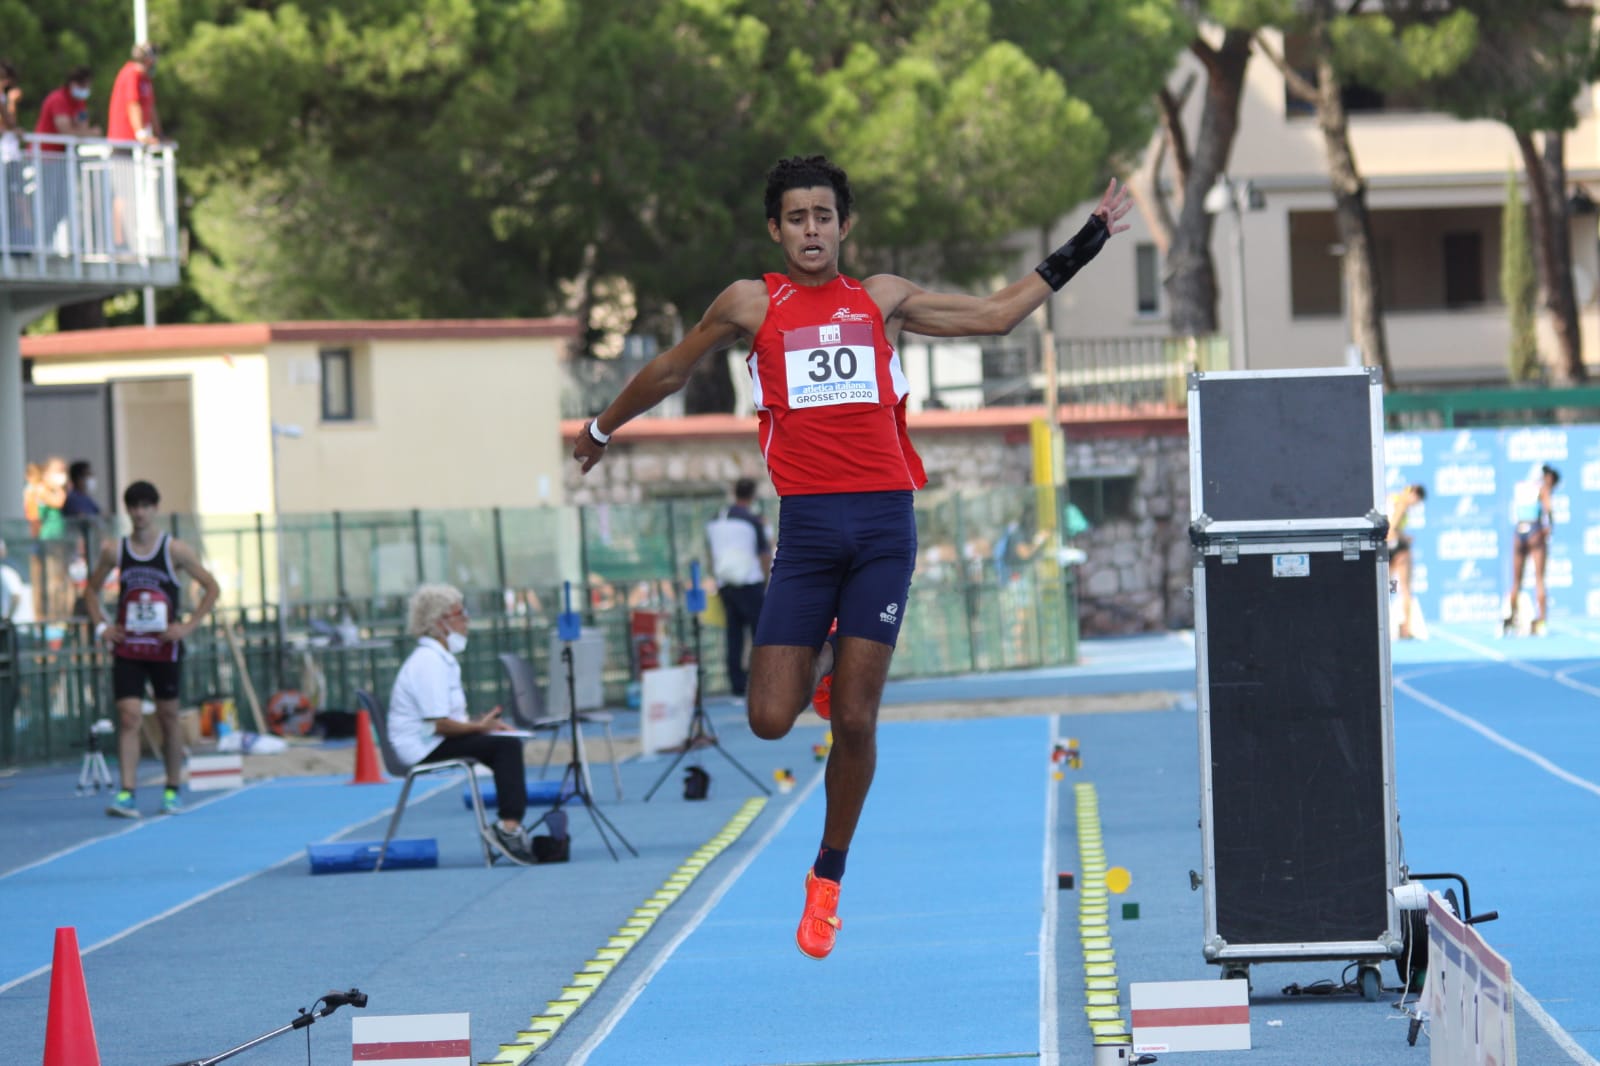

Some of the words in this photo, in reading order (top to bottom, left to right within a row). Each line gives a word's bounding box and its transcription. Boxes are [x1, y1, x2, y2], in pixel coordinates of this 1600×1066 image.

[808, 347, 857, 382] 30
[802, 384, 834, 394] atletica
[835, 382, 866, 391] italiana
[796, 391, 847, 403] GROSSETO
[850, 390, 873, 399] 2020
